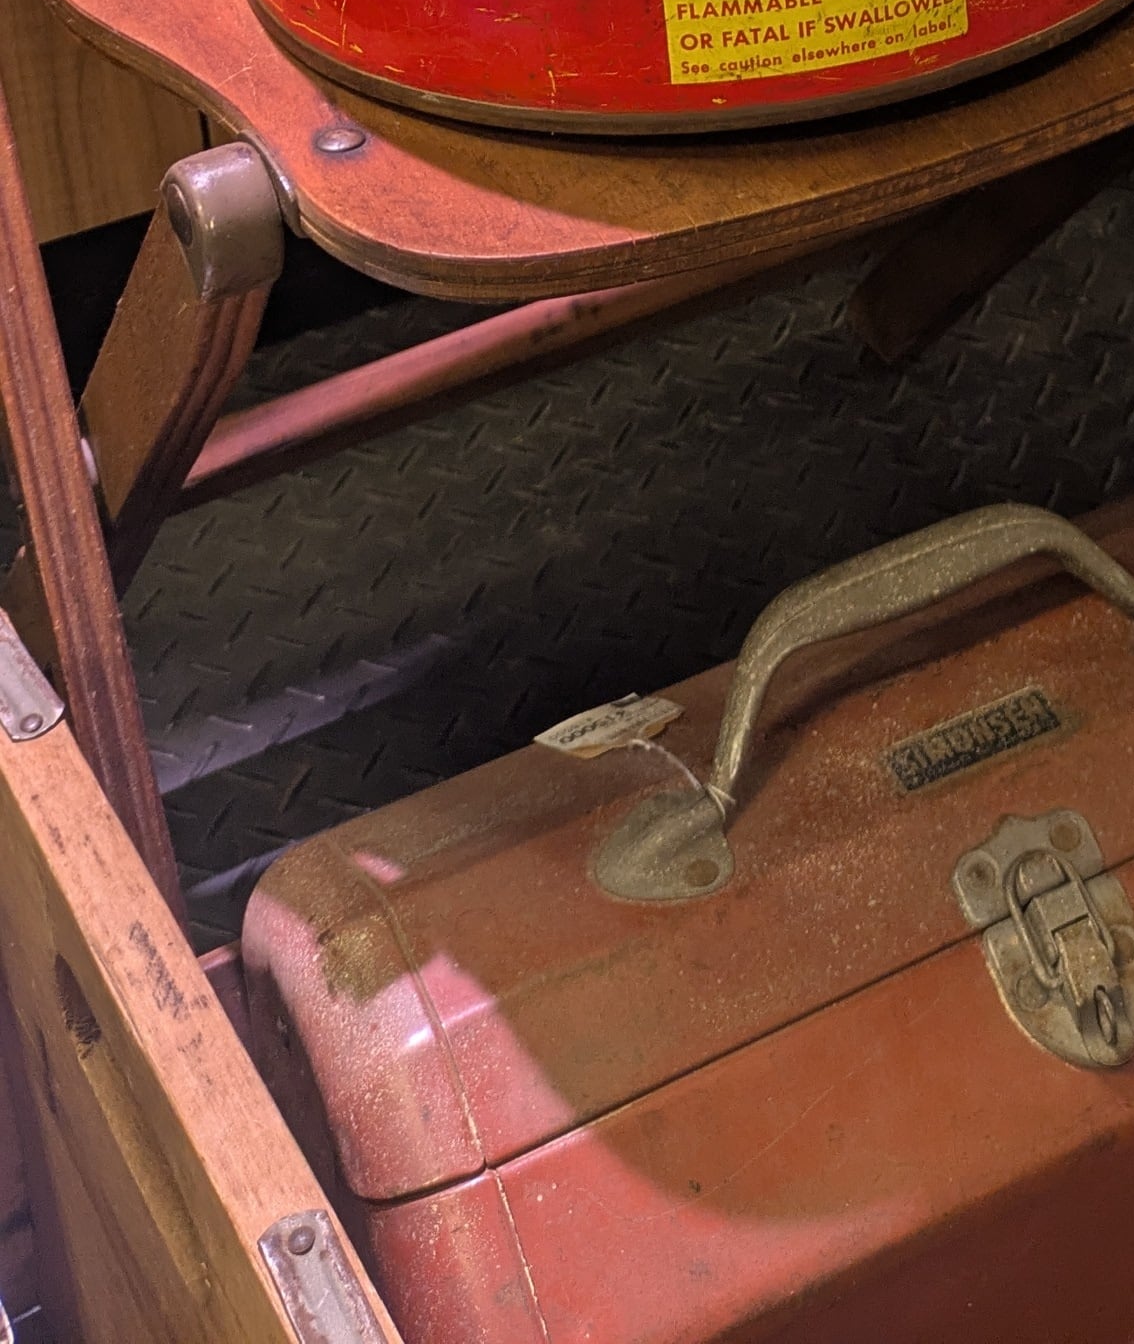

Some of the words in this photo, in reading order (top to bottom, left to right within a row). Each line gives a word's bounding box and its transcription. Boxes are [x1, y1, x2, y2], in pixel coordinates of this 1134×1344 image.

[680, 33, 713, 51] OR
[722, 27, 790, 48] FATAL
[798, 20, 816, 38] IF
[681, 61, 710, 75] See
[719, 55, 783, 73] caution
[792, 38, 876, 63] elsewhere
[885, 32, 904, 46] on
[913, 17, 957, 39] label.
